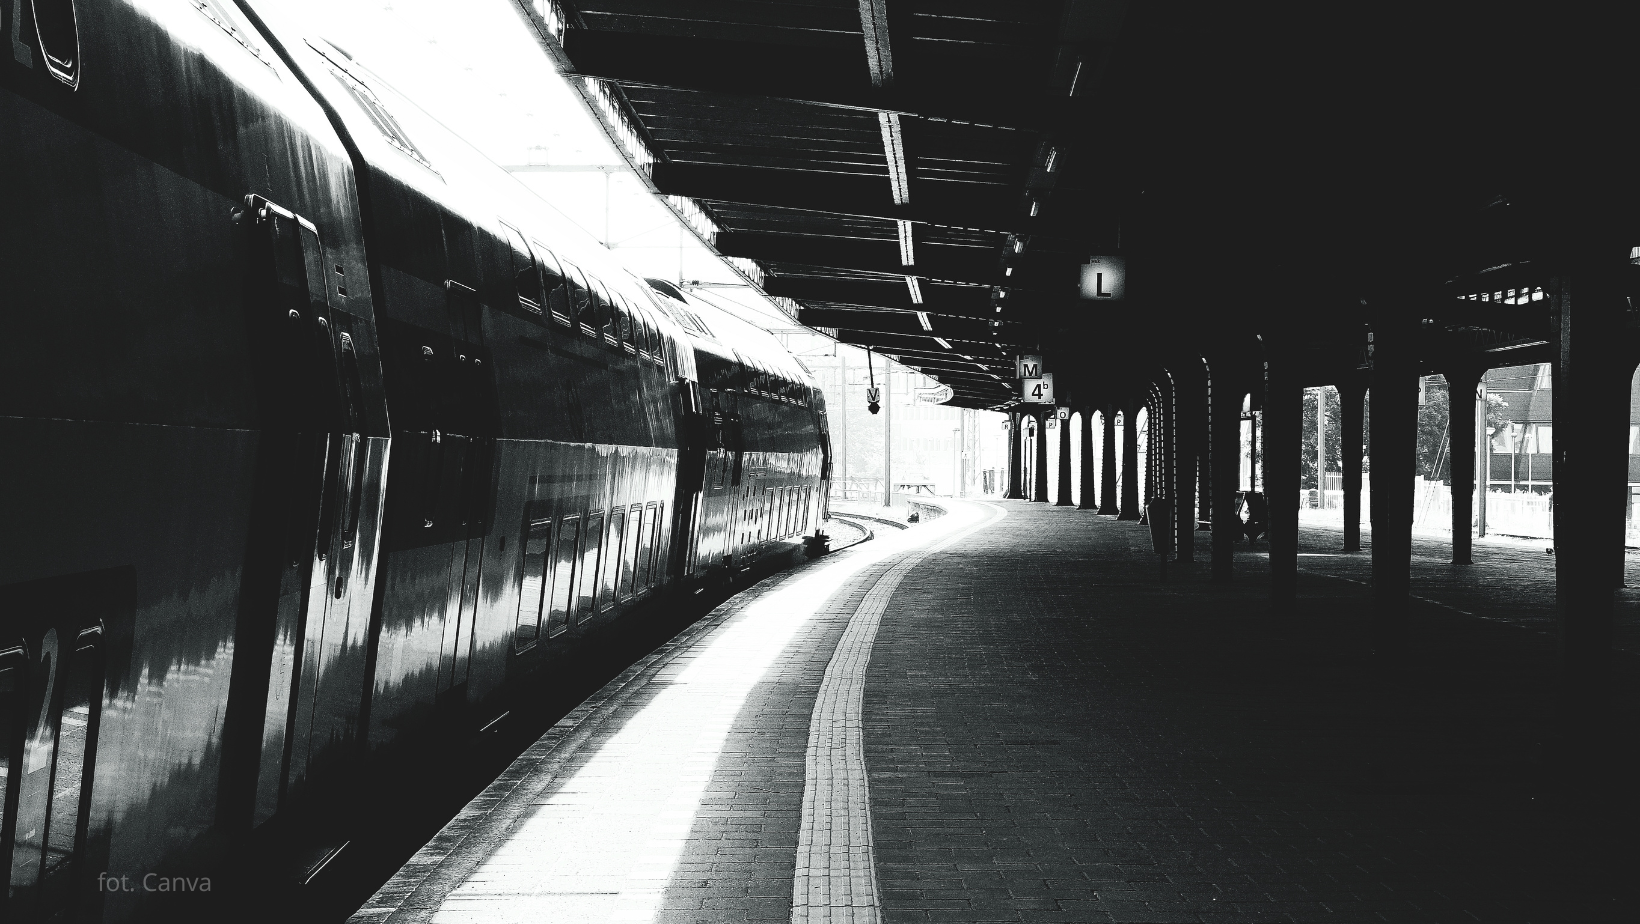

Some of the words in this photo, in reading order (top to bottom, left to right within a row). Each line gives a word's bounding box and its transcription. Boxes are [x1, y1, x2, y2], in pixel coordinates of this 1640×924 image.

[1097, 273, 1111, 297] L
[1023, 364, 1038, 376] M
[868, 388, 879, 401] V
